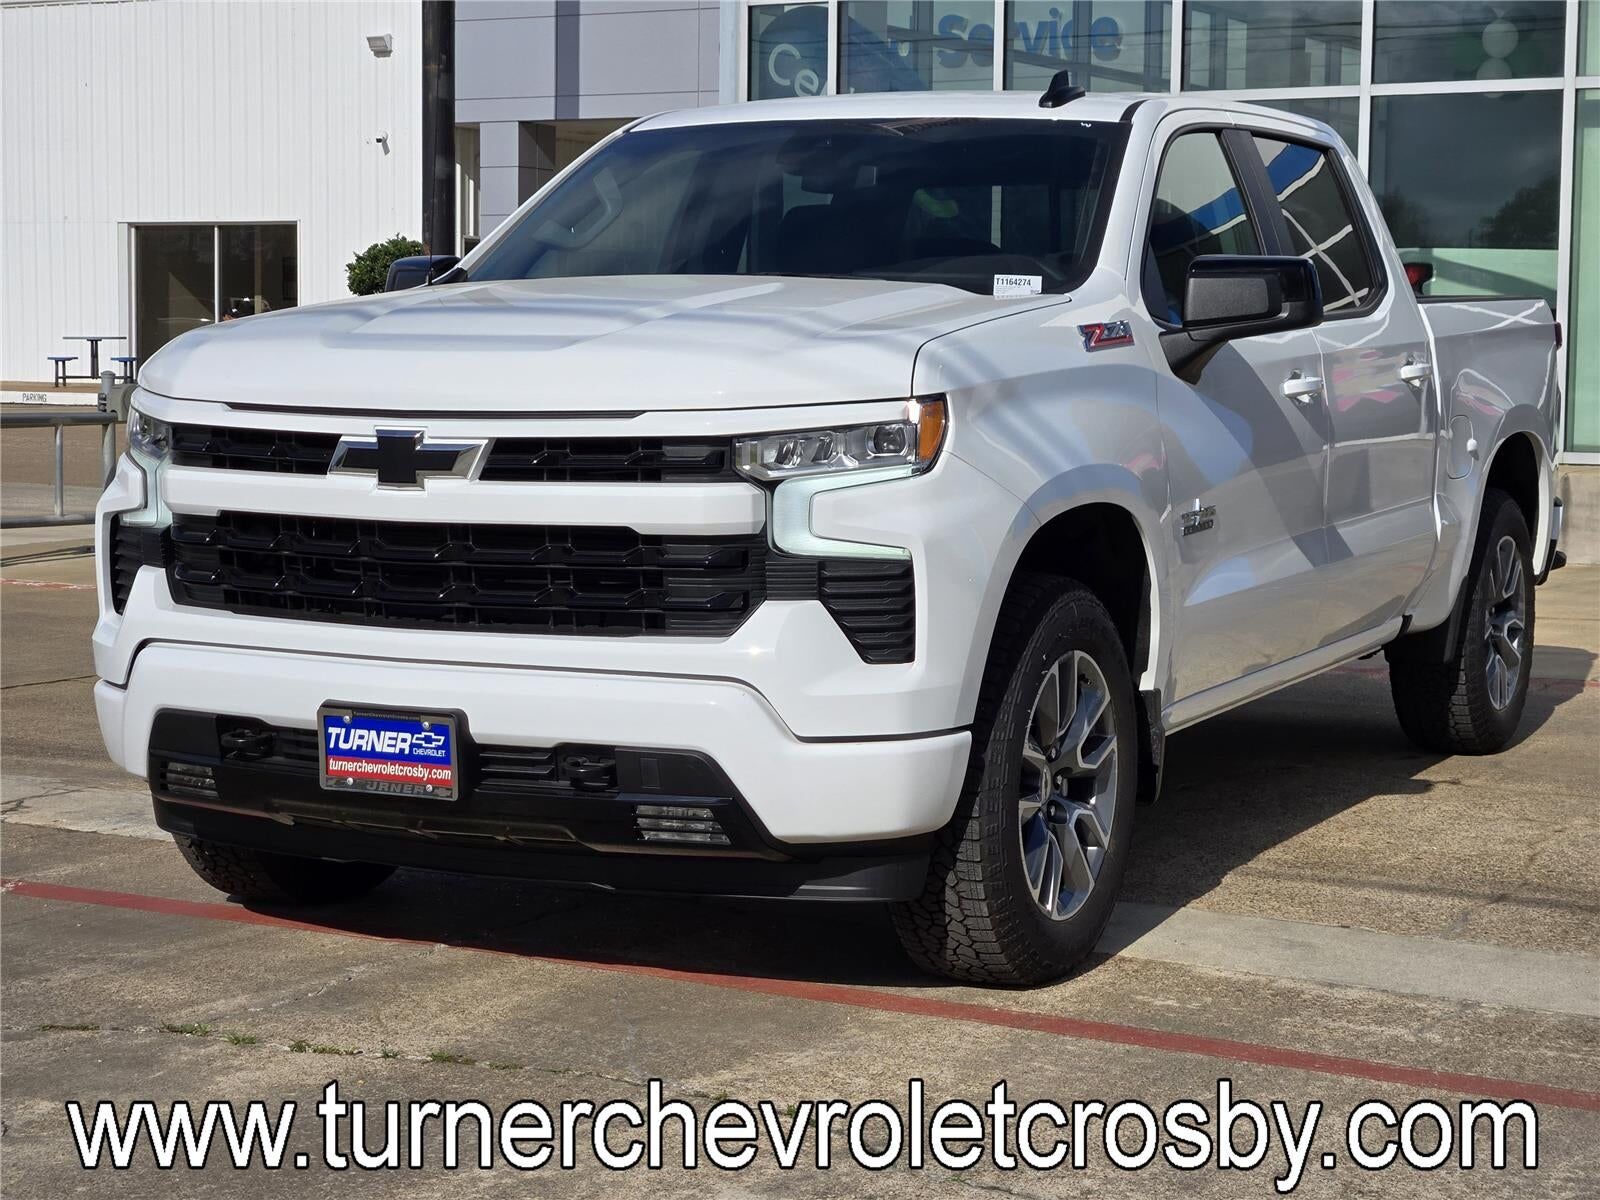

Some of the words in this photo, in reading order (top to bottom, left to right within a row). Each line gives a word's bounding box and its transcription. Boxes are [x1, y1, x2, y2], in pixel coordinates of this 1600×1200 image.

[938, 8, 1121, 69] Sevice
[996, 277, 1031, 286] T1164274
[22, 393, 47, 402] PARKING
[328, 727, 411, 754] TURNER
[412, 748, 446, 757] CHEVROLET
[329, 758, 451, 781] turnerchevroletcrosby.com
